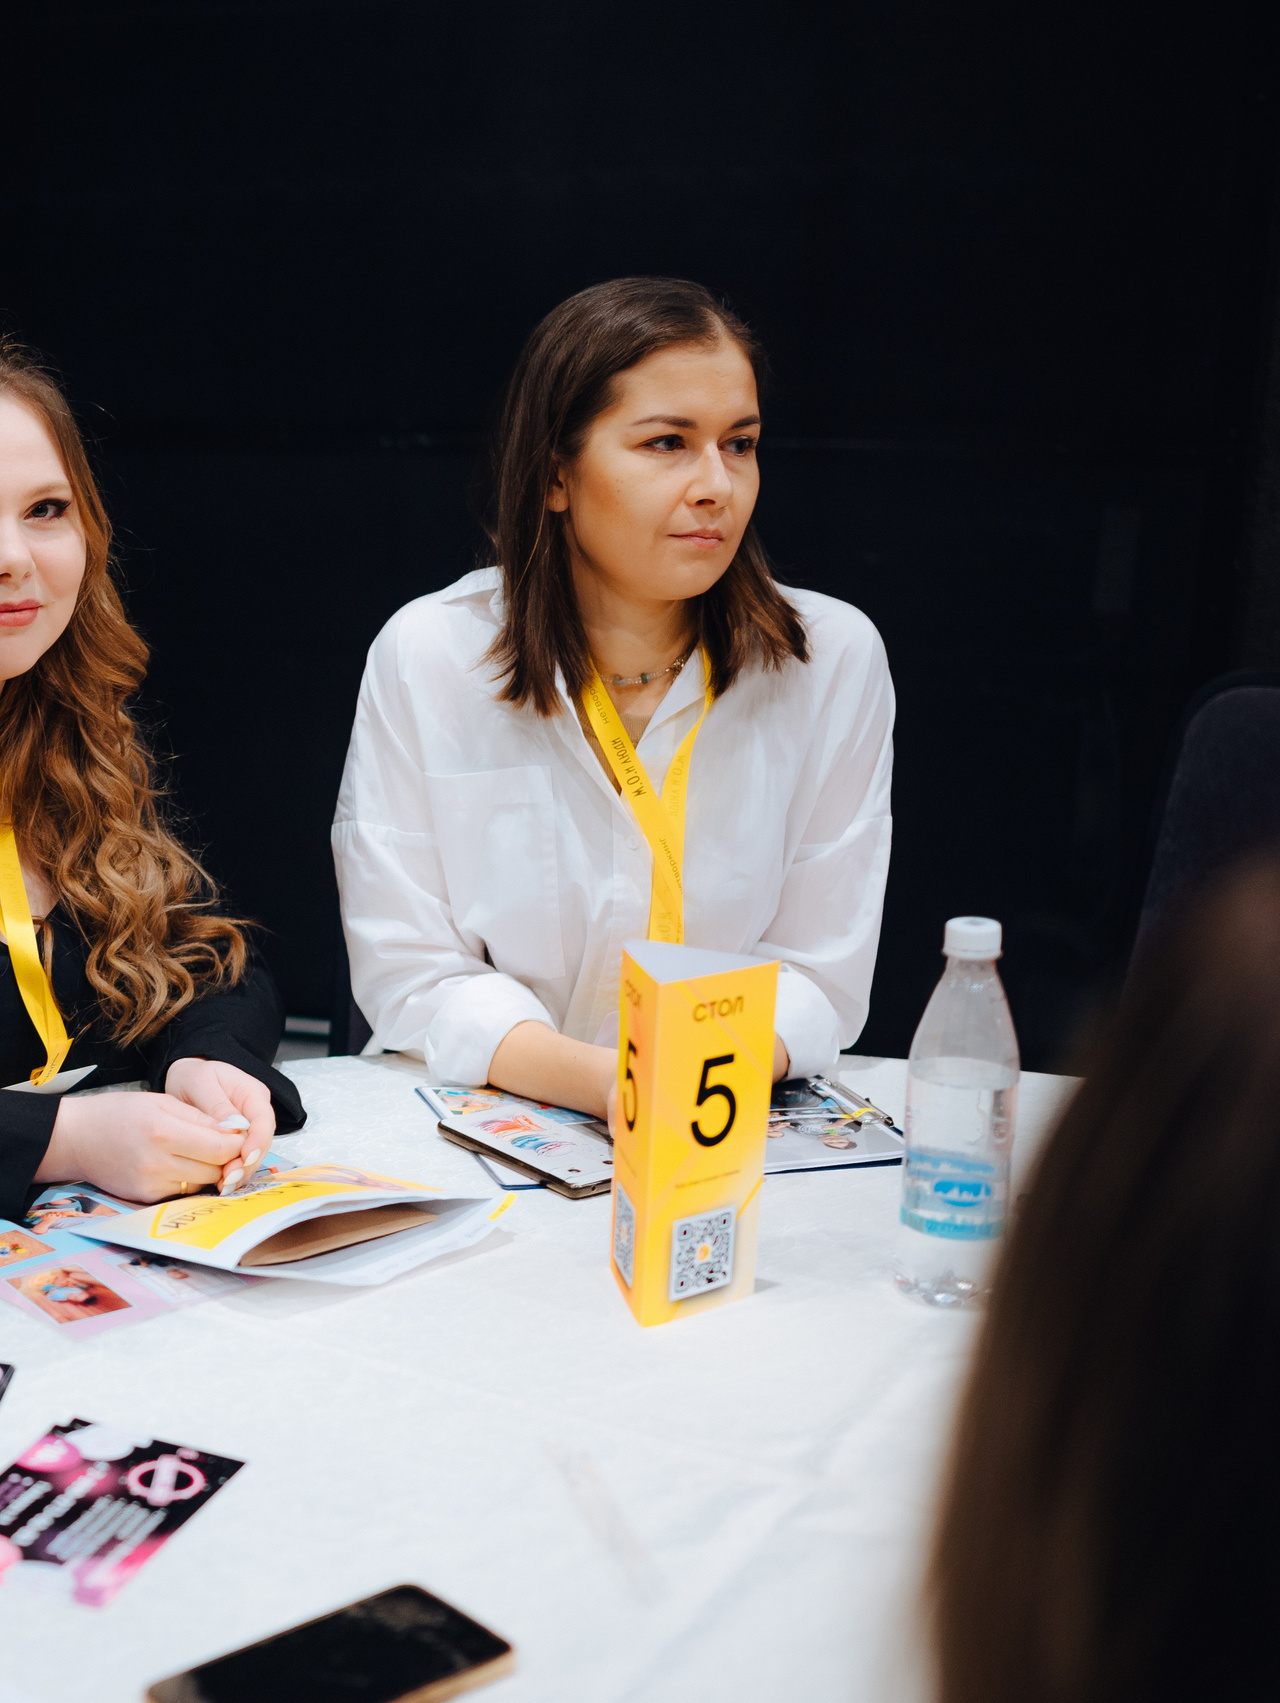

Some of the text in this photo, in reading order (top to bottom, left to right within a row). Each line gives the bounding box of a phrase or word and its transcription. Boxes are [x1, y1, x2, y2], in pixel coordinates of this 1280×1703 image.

[587, 683, 611, 725] нетворк
[693, 995, 744, 1022] СТОЛ
[623, 1039, 639, 1132] 5
[690, 1053, 737, 1148] 5
